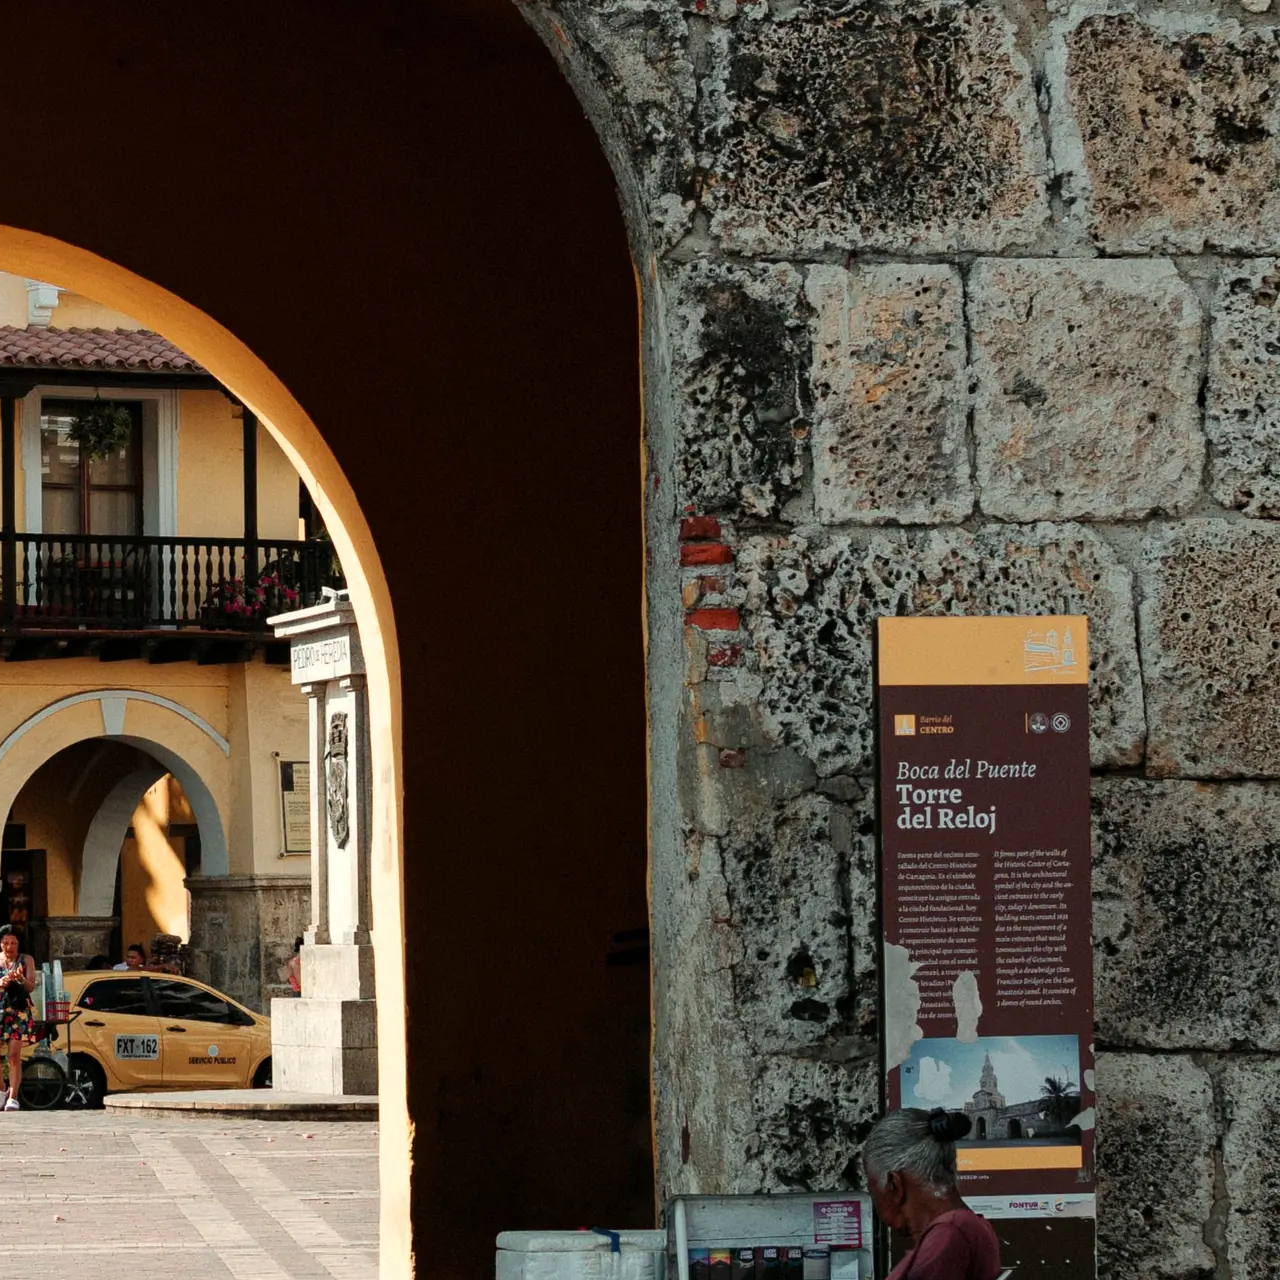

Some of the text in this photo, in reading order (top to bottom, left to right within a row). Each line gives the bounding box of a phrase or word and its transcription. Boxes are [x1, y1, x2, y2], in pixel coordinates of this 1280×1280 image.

[293, 647, 315, 670] PEDRO
[920, 714, 953, 724] Barrio del
[920, 725, 954, 735] CENTRO
[896, 759, 1037, 780] Boca del Puente
[896, 784, 963, 805] Torre
[896, 805, 996, 835] del Reloj
[116, 1039, 158, 1054] FXT 162
[188, 1057, 213, 1065] SERVICIO
